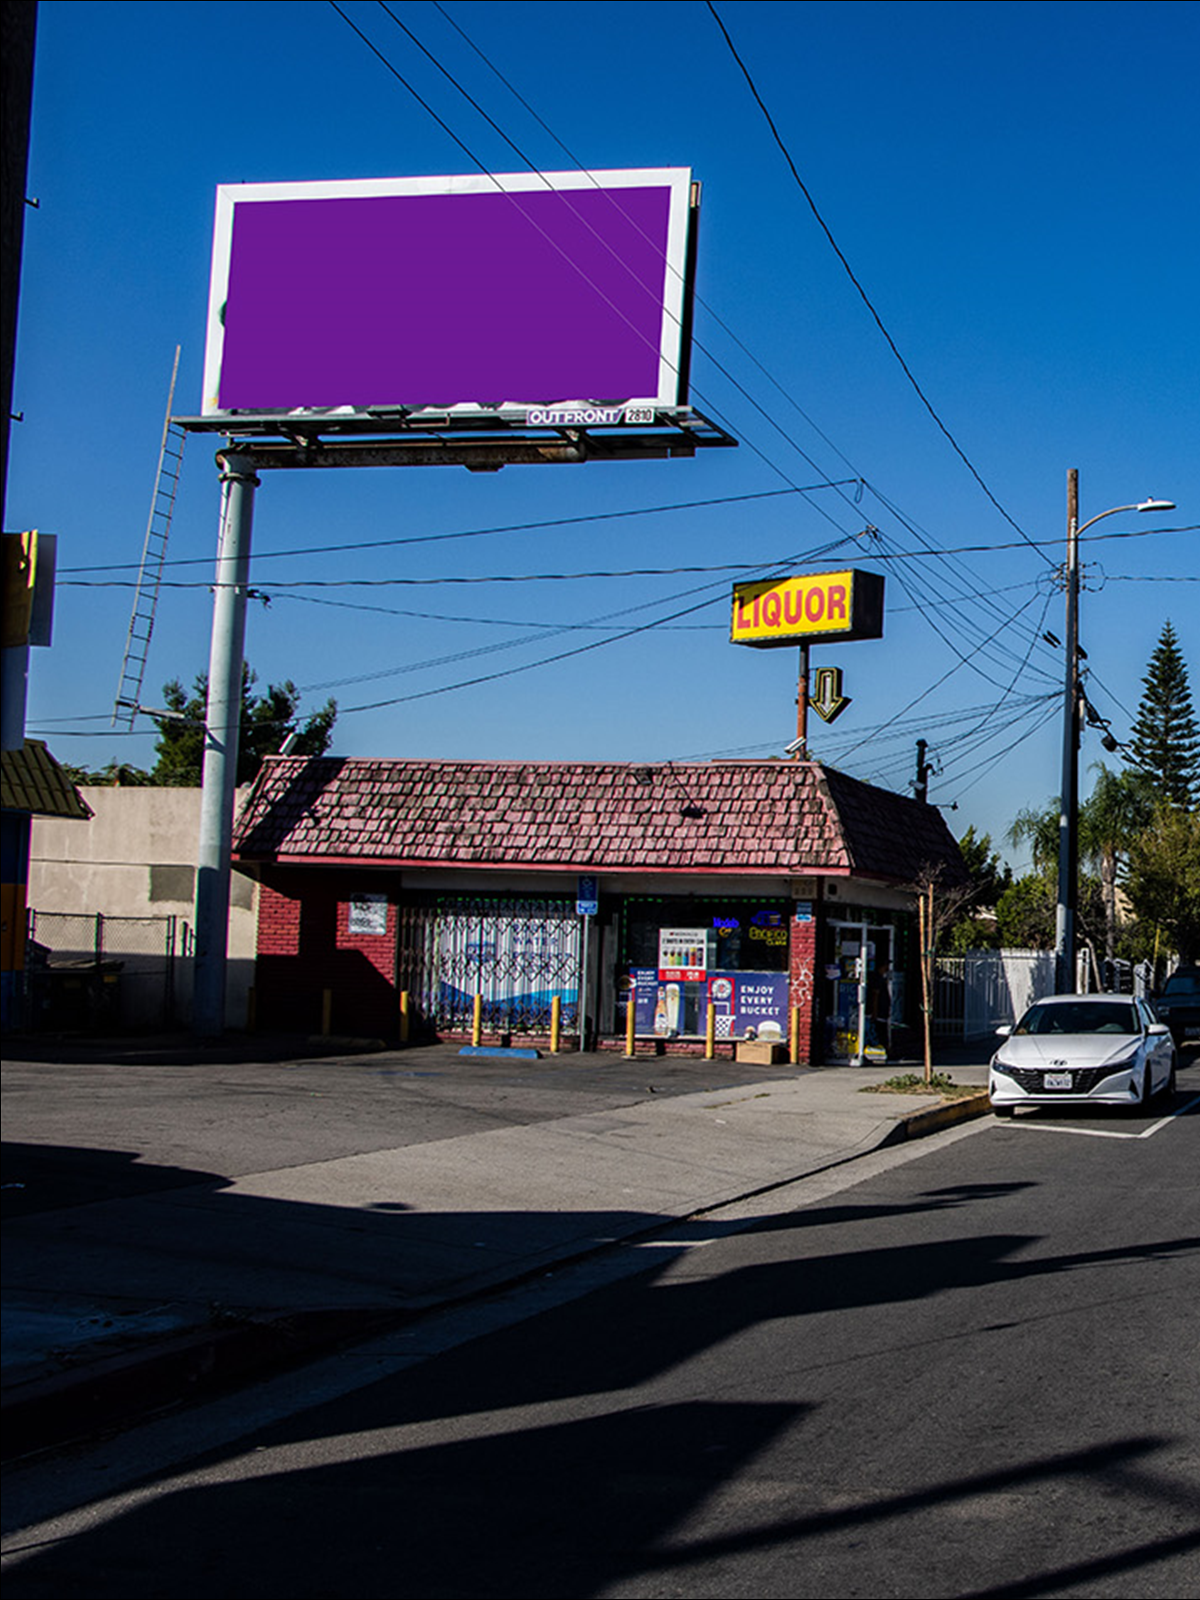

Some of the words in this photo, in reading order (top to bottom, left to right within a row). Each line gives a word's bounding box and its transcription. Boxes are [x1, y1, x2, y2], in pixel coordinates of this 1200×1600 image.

[530, 410, 618, 424] OUTFRONT
[628, 409, 652, 422] 2810
[737, 585, 846, 630] LIQUOR
[740, 985, 774, 995] ENJOY
[740, 995, 773, 1005] EVERY
[740, 1006, 780, 1016] BUCKET
